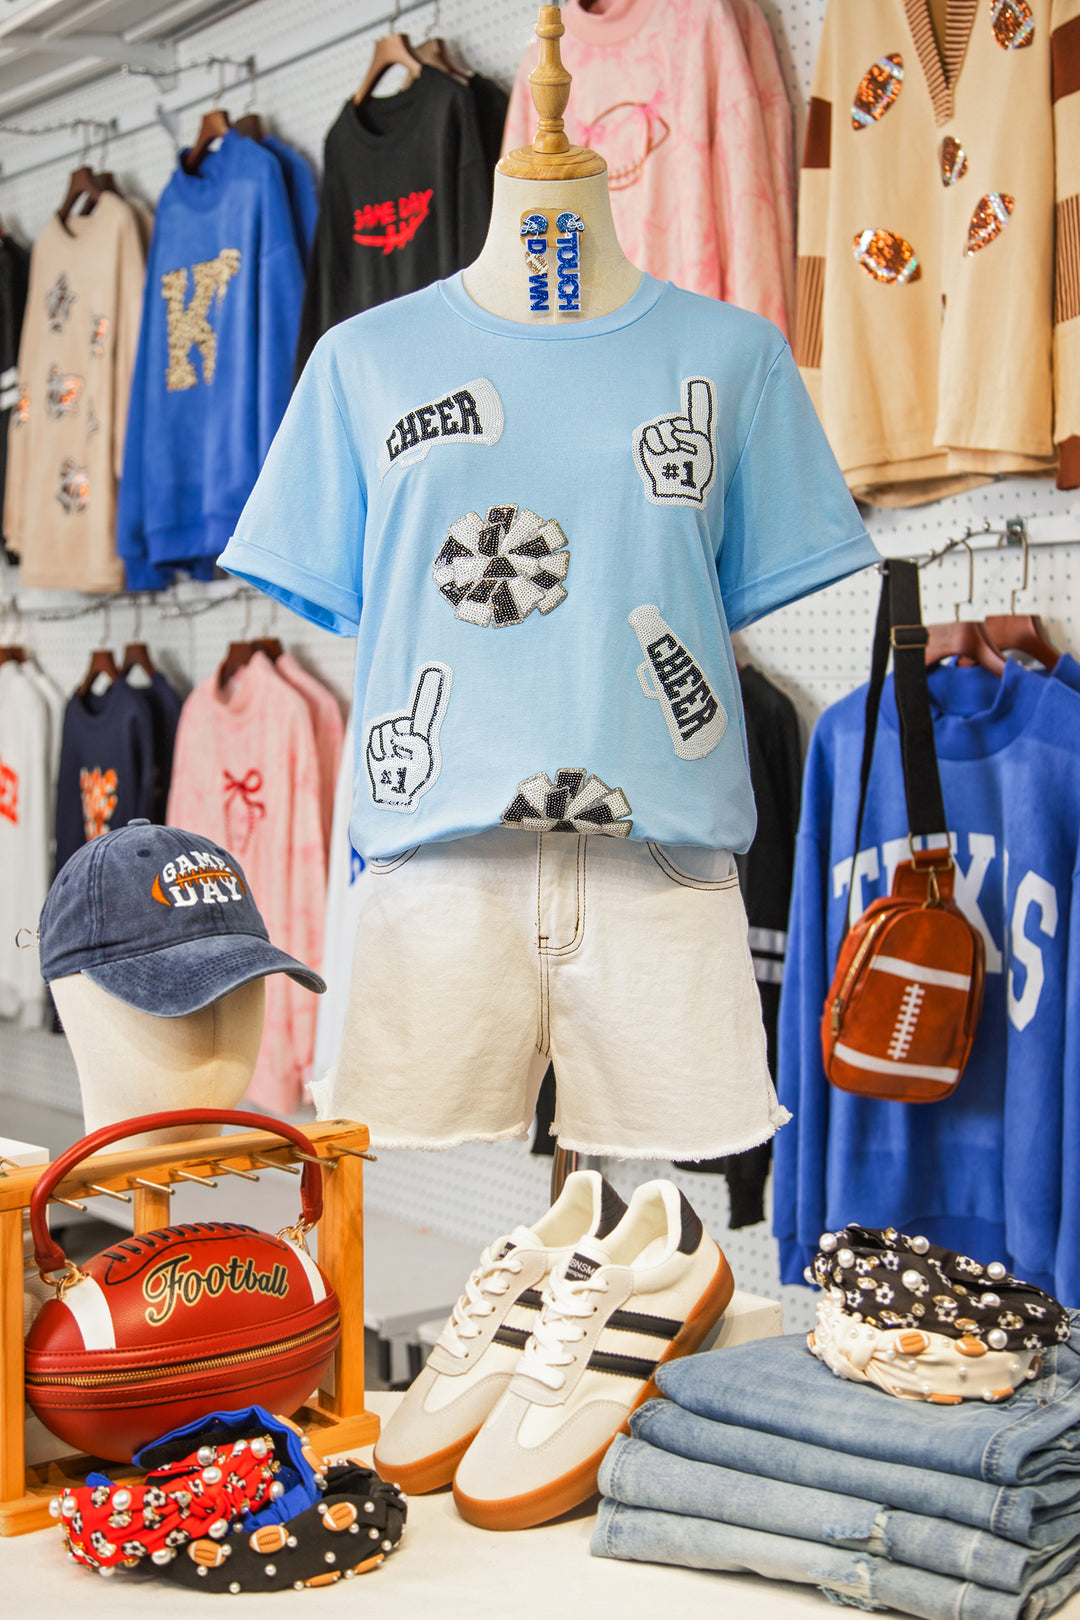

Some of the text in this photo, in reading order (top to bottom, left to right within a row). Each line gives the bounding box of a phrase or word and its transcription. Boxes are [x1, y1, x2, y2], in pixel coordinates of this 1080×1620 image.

[556, 232, 580, 311] TOUCH
[385, 389, 483, 461] CHEER
[661, 461, 697, 489] #1
[647, 633, 718, 741] CHEER
[381, 767, 407, 793] #1
[168, 876, 242, 907] DAY
[143, 1253, 289, 1327] Football
